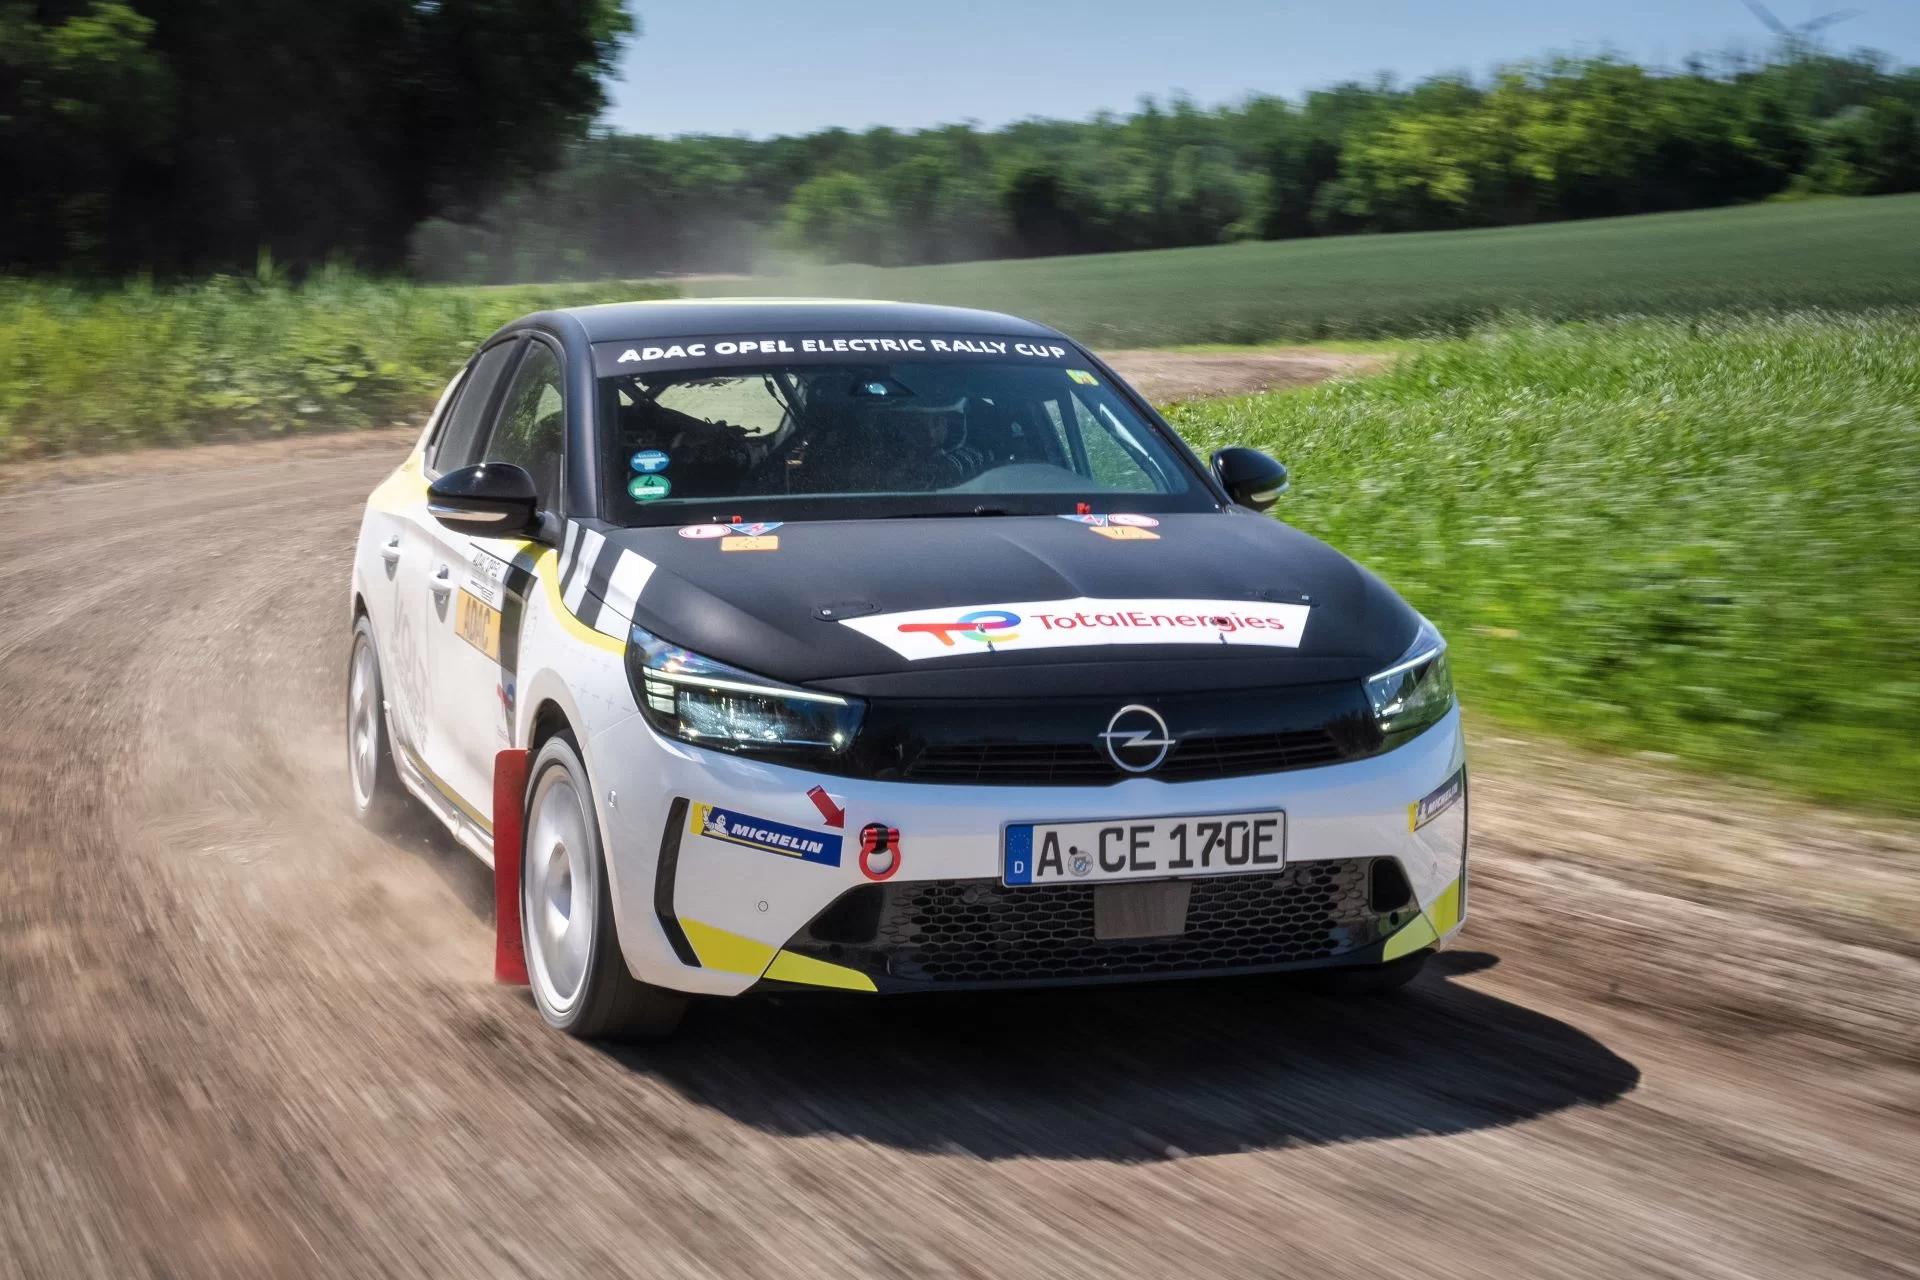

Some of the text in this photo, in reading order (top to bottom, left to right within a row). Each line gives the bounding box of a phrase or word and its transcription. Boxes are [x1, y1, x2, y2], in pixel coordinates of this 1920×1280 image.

[616, 339, 1066, 363] ADAC OPEL ELECTRIC RALLY CUP
[644, 475, 655, 487] 4
[1030, 611, 1284, 632] TotalEnergies
[731, 823, 824, 854] MICHELIN
[1036, 818, 1279, 877] A CE 170E
[1014, 860, 1024, 875] D
